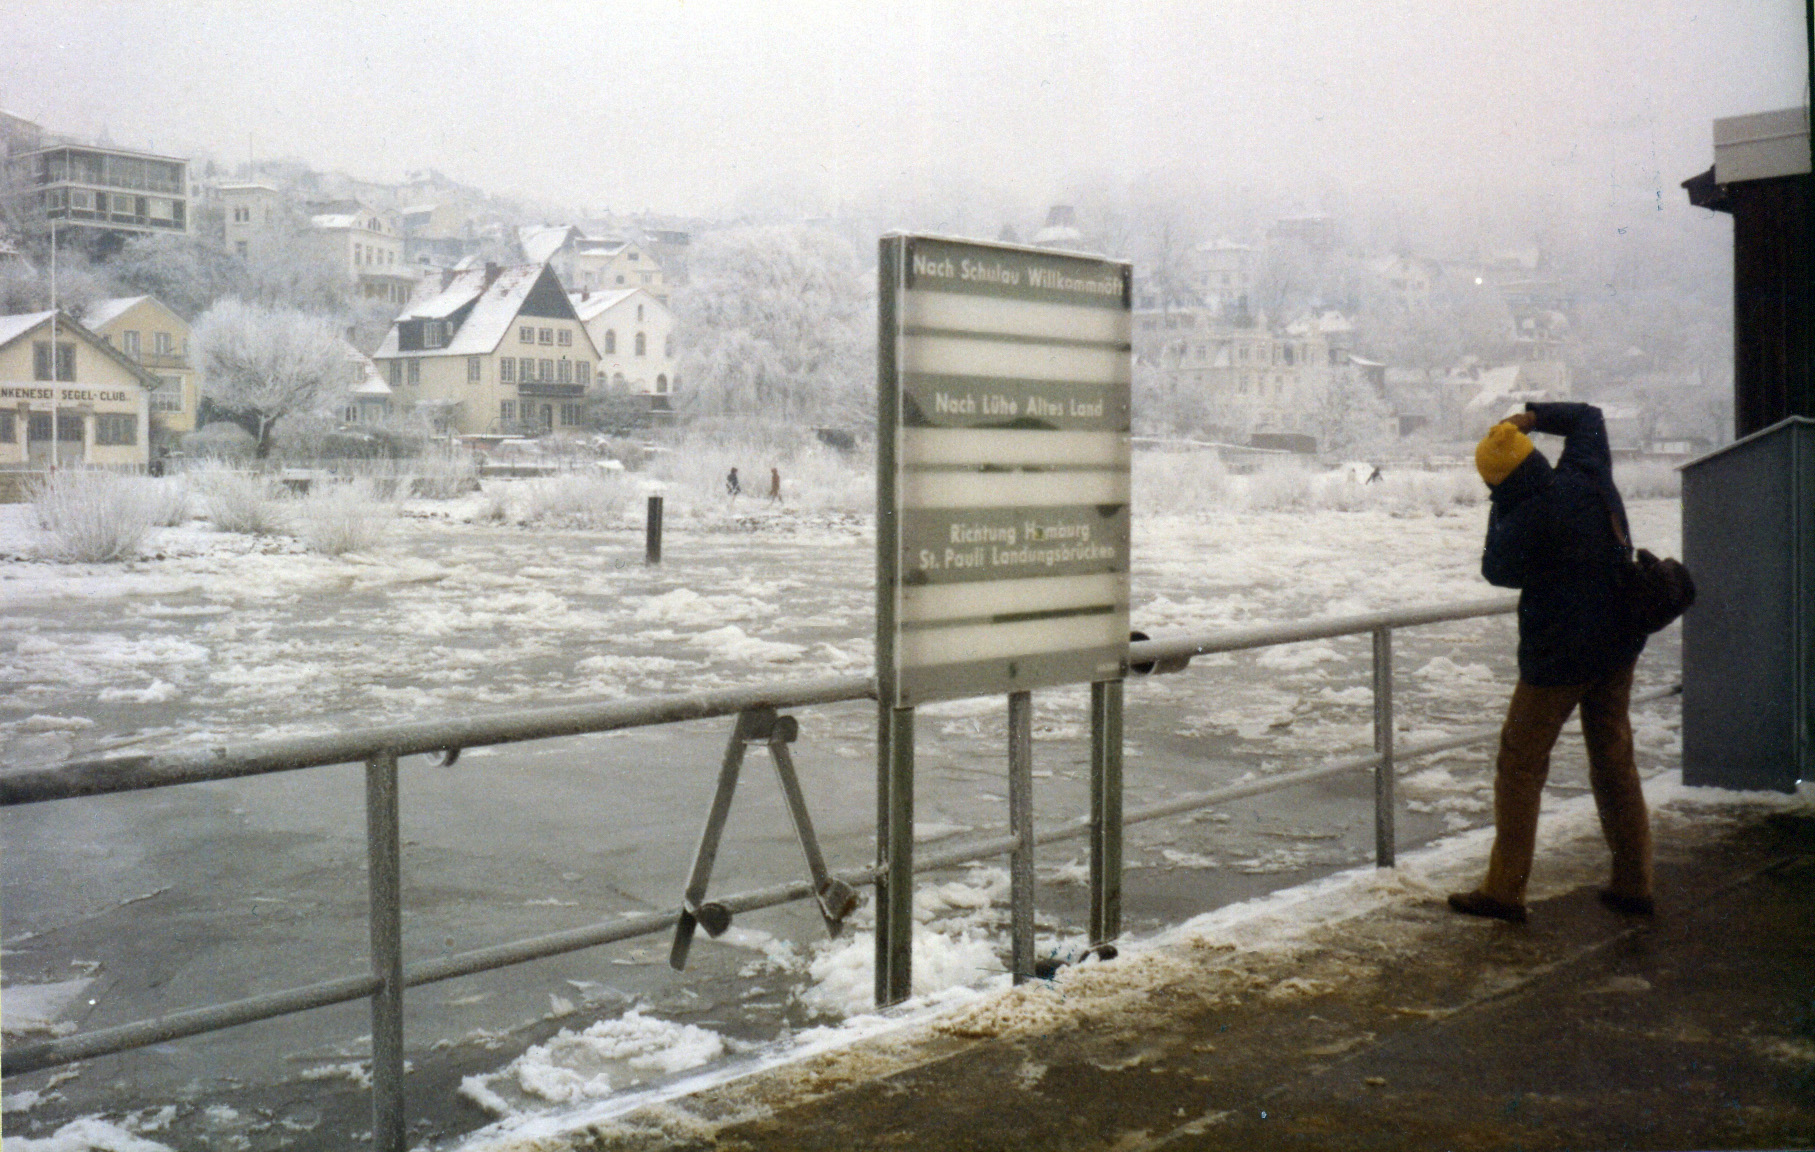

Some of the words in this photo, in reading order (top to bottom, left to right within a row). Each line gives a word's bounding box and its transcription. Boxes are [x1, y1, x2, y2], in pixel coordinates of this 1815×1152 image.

[913, 254, 954, 278] Nach
[961, 259, 1020, 285] Schulau
[0, 387, 54, 400] NKENESE
[935, 391, 976, 414] Nach
[982, 394, 1018, 415] Lühe
[1026, 396, 1064, 416] Altes
[1070, 398, 1103, 417] Land
[950, 523, 1016, 545] Richtung
[919, 549, 940, 570] St.
[944, 546, 984, 569] Pauli
[991, 542, 1115, 566] Landungsbrücken
